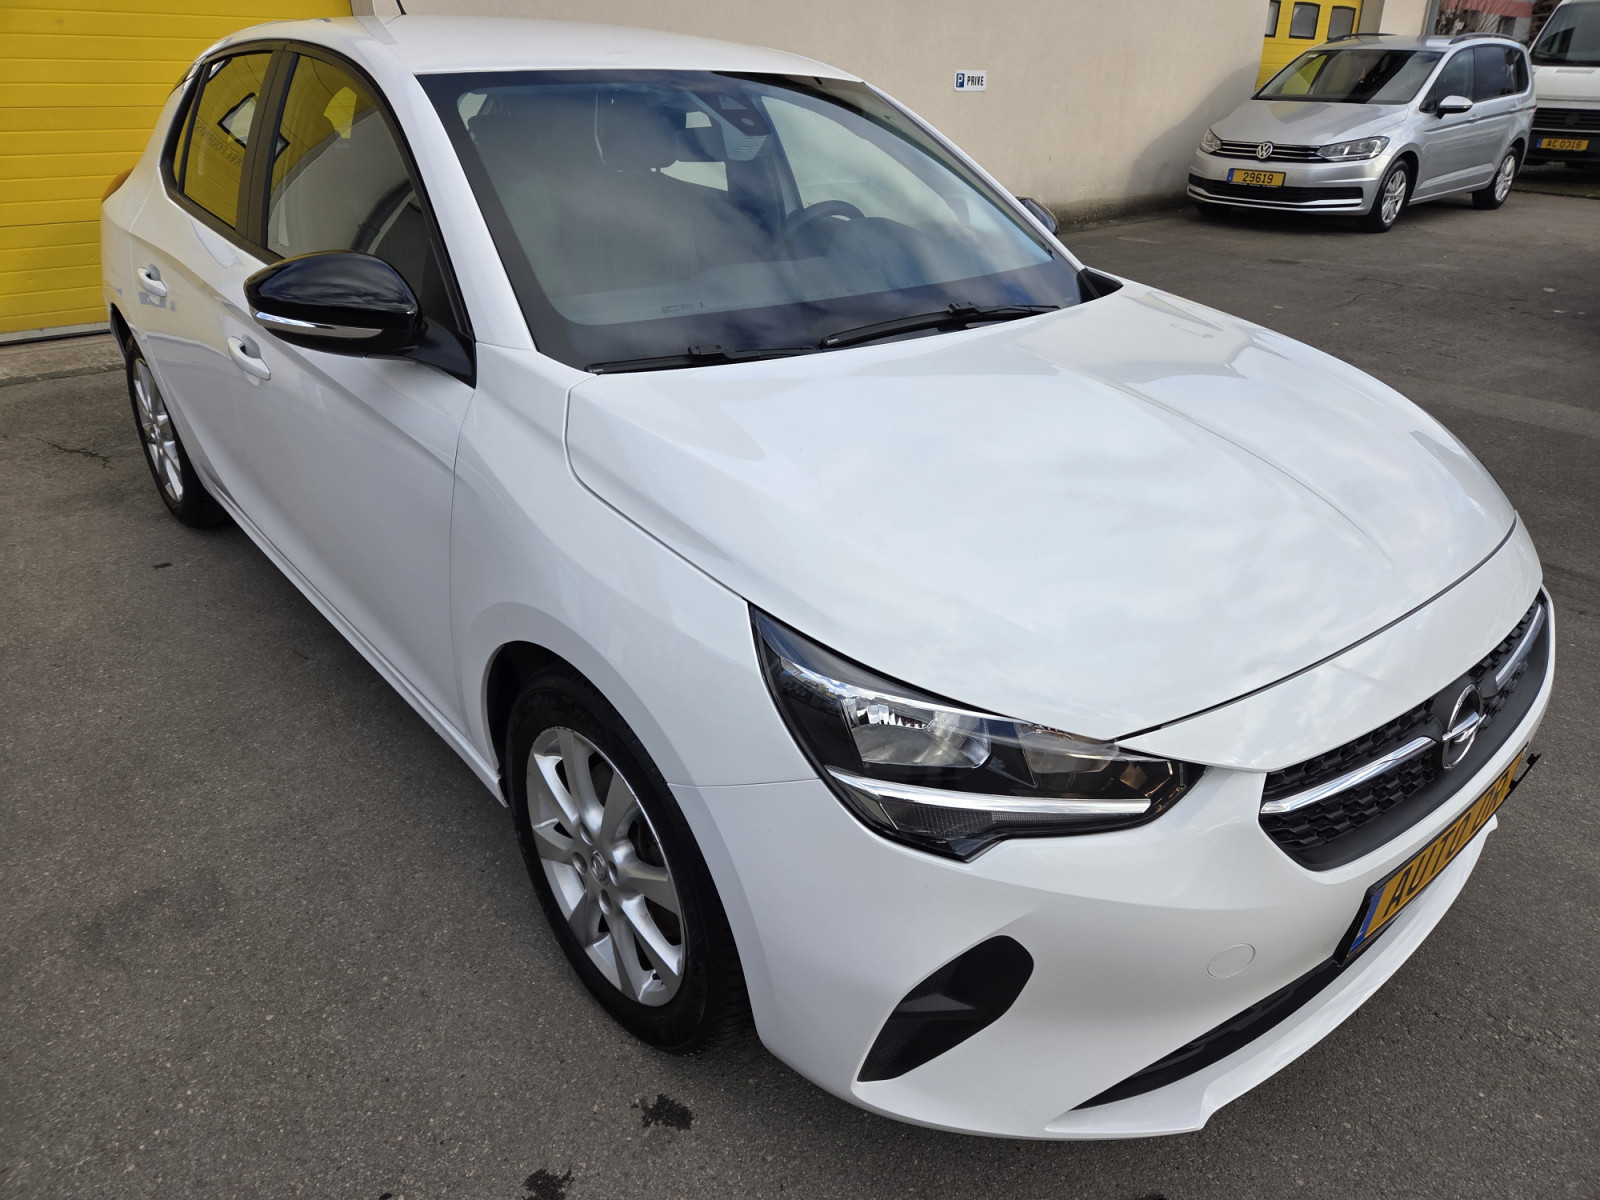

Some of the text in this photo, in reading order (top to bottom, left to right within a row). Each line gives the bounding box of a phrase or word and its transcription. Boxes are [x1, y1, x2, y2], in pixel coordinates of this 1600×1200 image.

[967, 76, 984, 86] PRIVE
[1546, 140, 1558, 148] AC
[1242, 171, 1274, 184] 29619
[1382, 811, 1472, 919] AUTO
